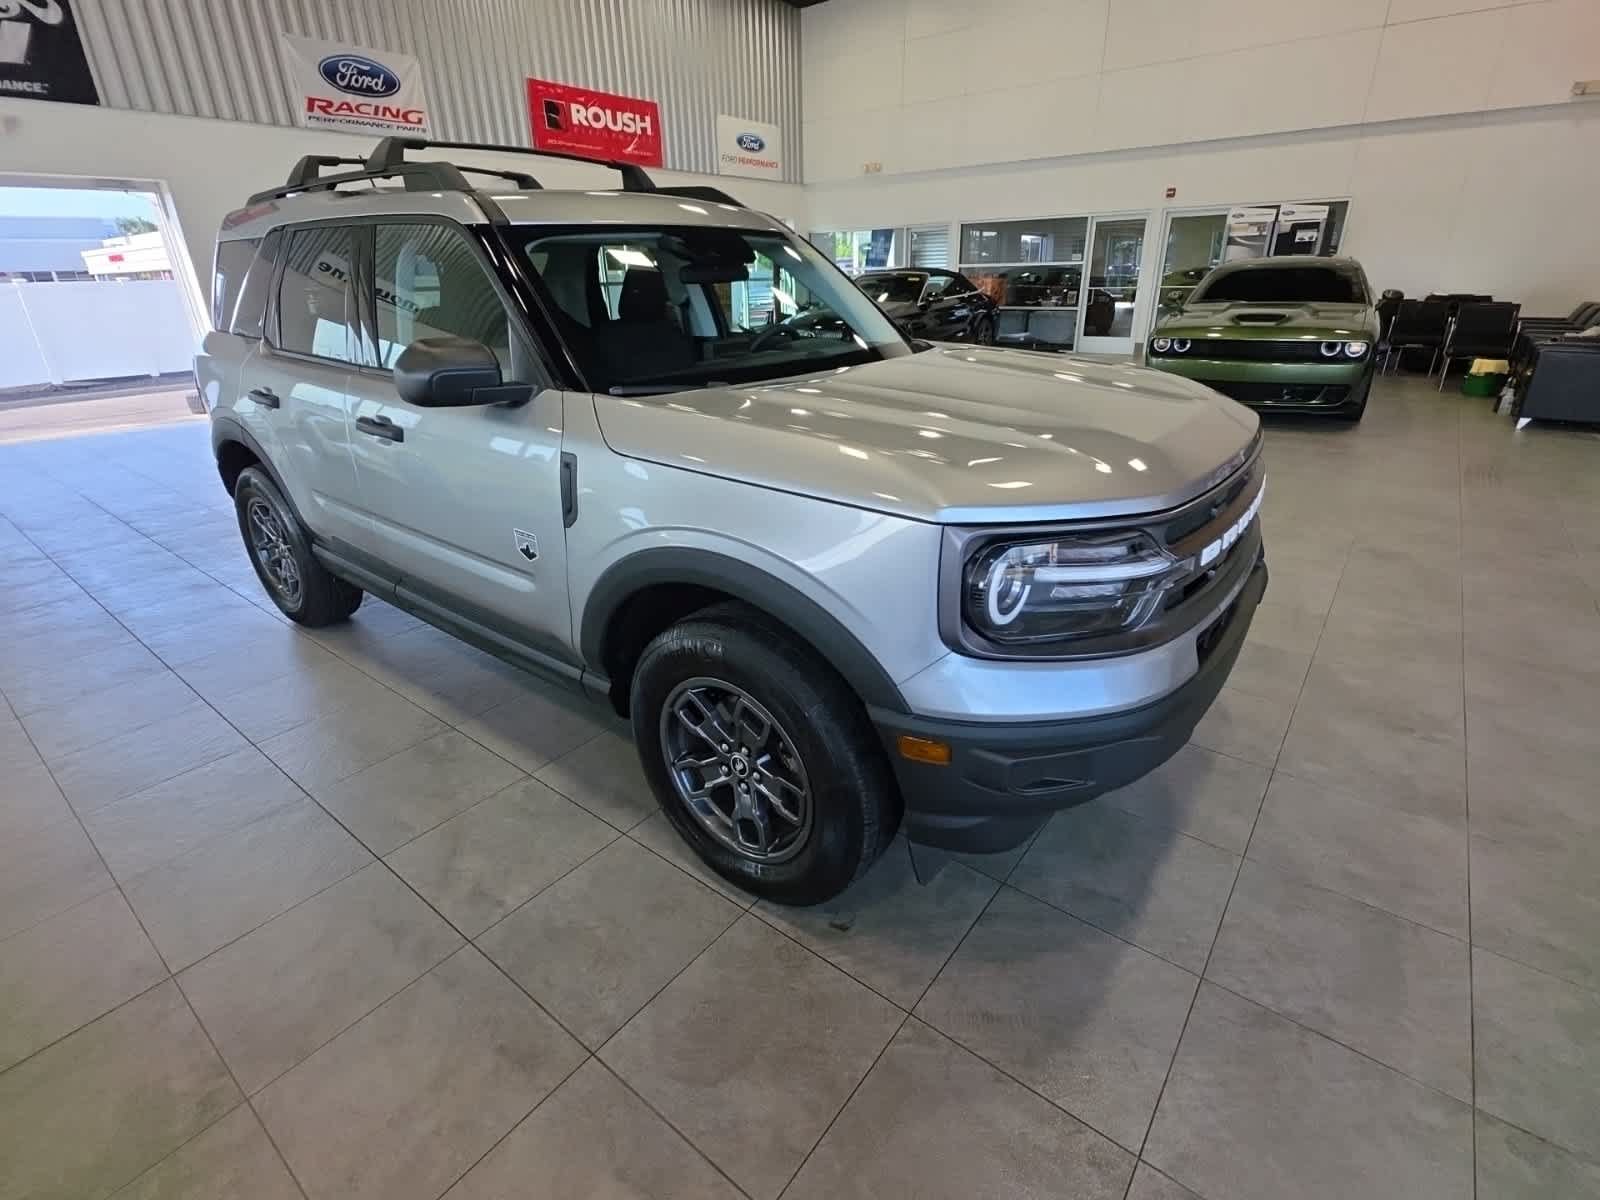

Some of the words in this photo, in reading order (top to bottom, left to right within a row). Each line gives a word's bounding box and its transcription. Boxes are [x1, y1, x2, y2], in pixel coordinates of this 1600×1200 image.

[0, 79, 42, 92] ANCE
[336, 60, 386, 91] Ford
[306, 97, 424, 125] RACING
[308, 115, 394, 129] PERFORMANCE
[396, 125, 427, 134] PARTS
[570, 103, 652, 136] ROUSH
